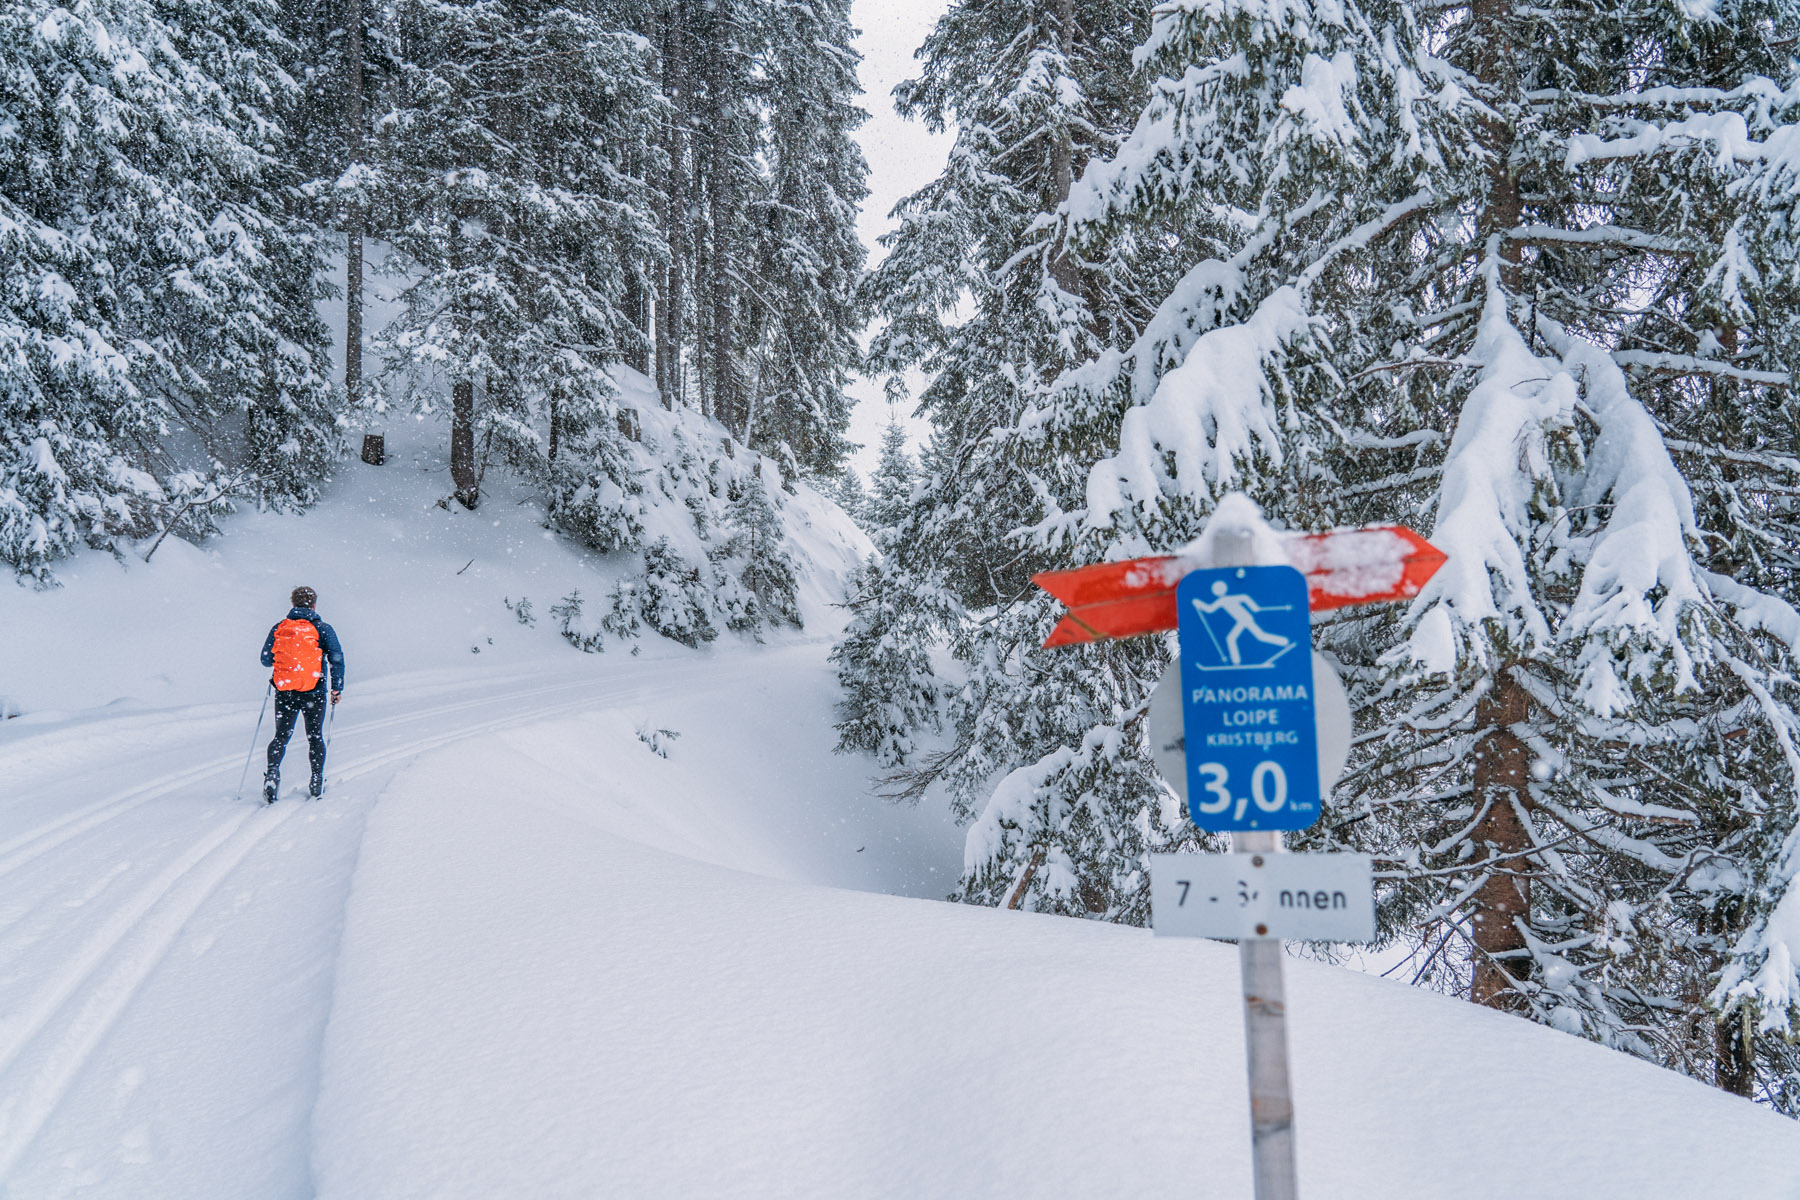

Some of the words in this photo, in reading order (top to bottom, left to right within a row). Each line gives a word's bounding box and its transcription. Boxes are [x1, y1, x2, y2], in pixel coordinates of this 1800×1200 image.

[1192, 685, 1308, 703] PANORAMA
[1223, 709, 1279, 726] LOIPE
[1206, 731, 1298, 746] KRISTBERG
[1198, 760, 1287, 821] 3,0
[1290, 800, 1313, 812] km
[1176, 880, 1191, 907] 7
